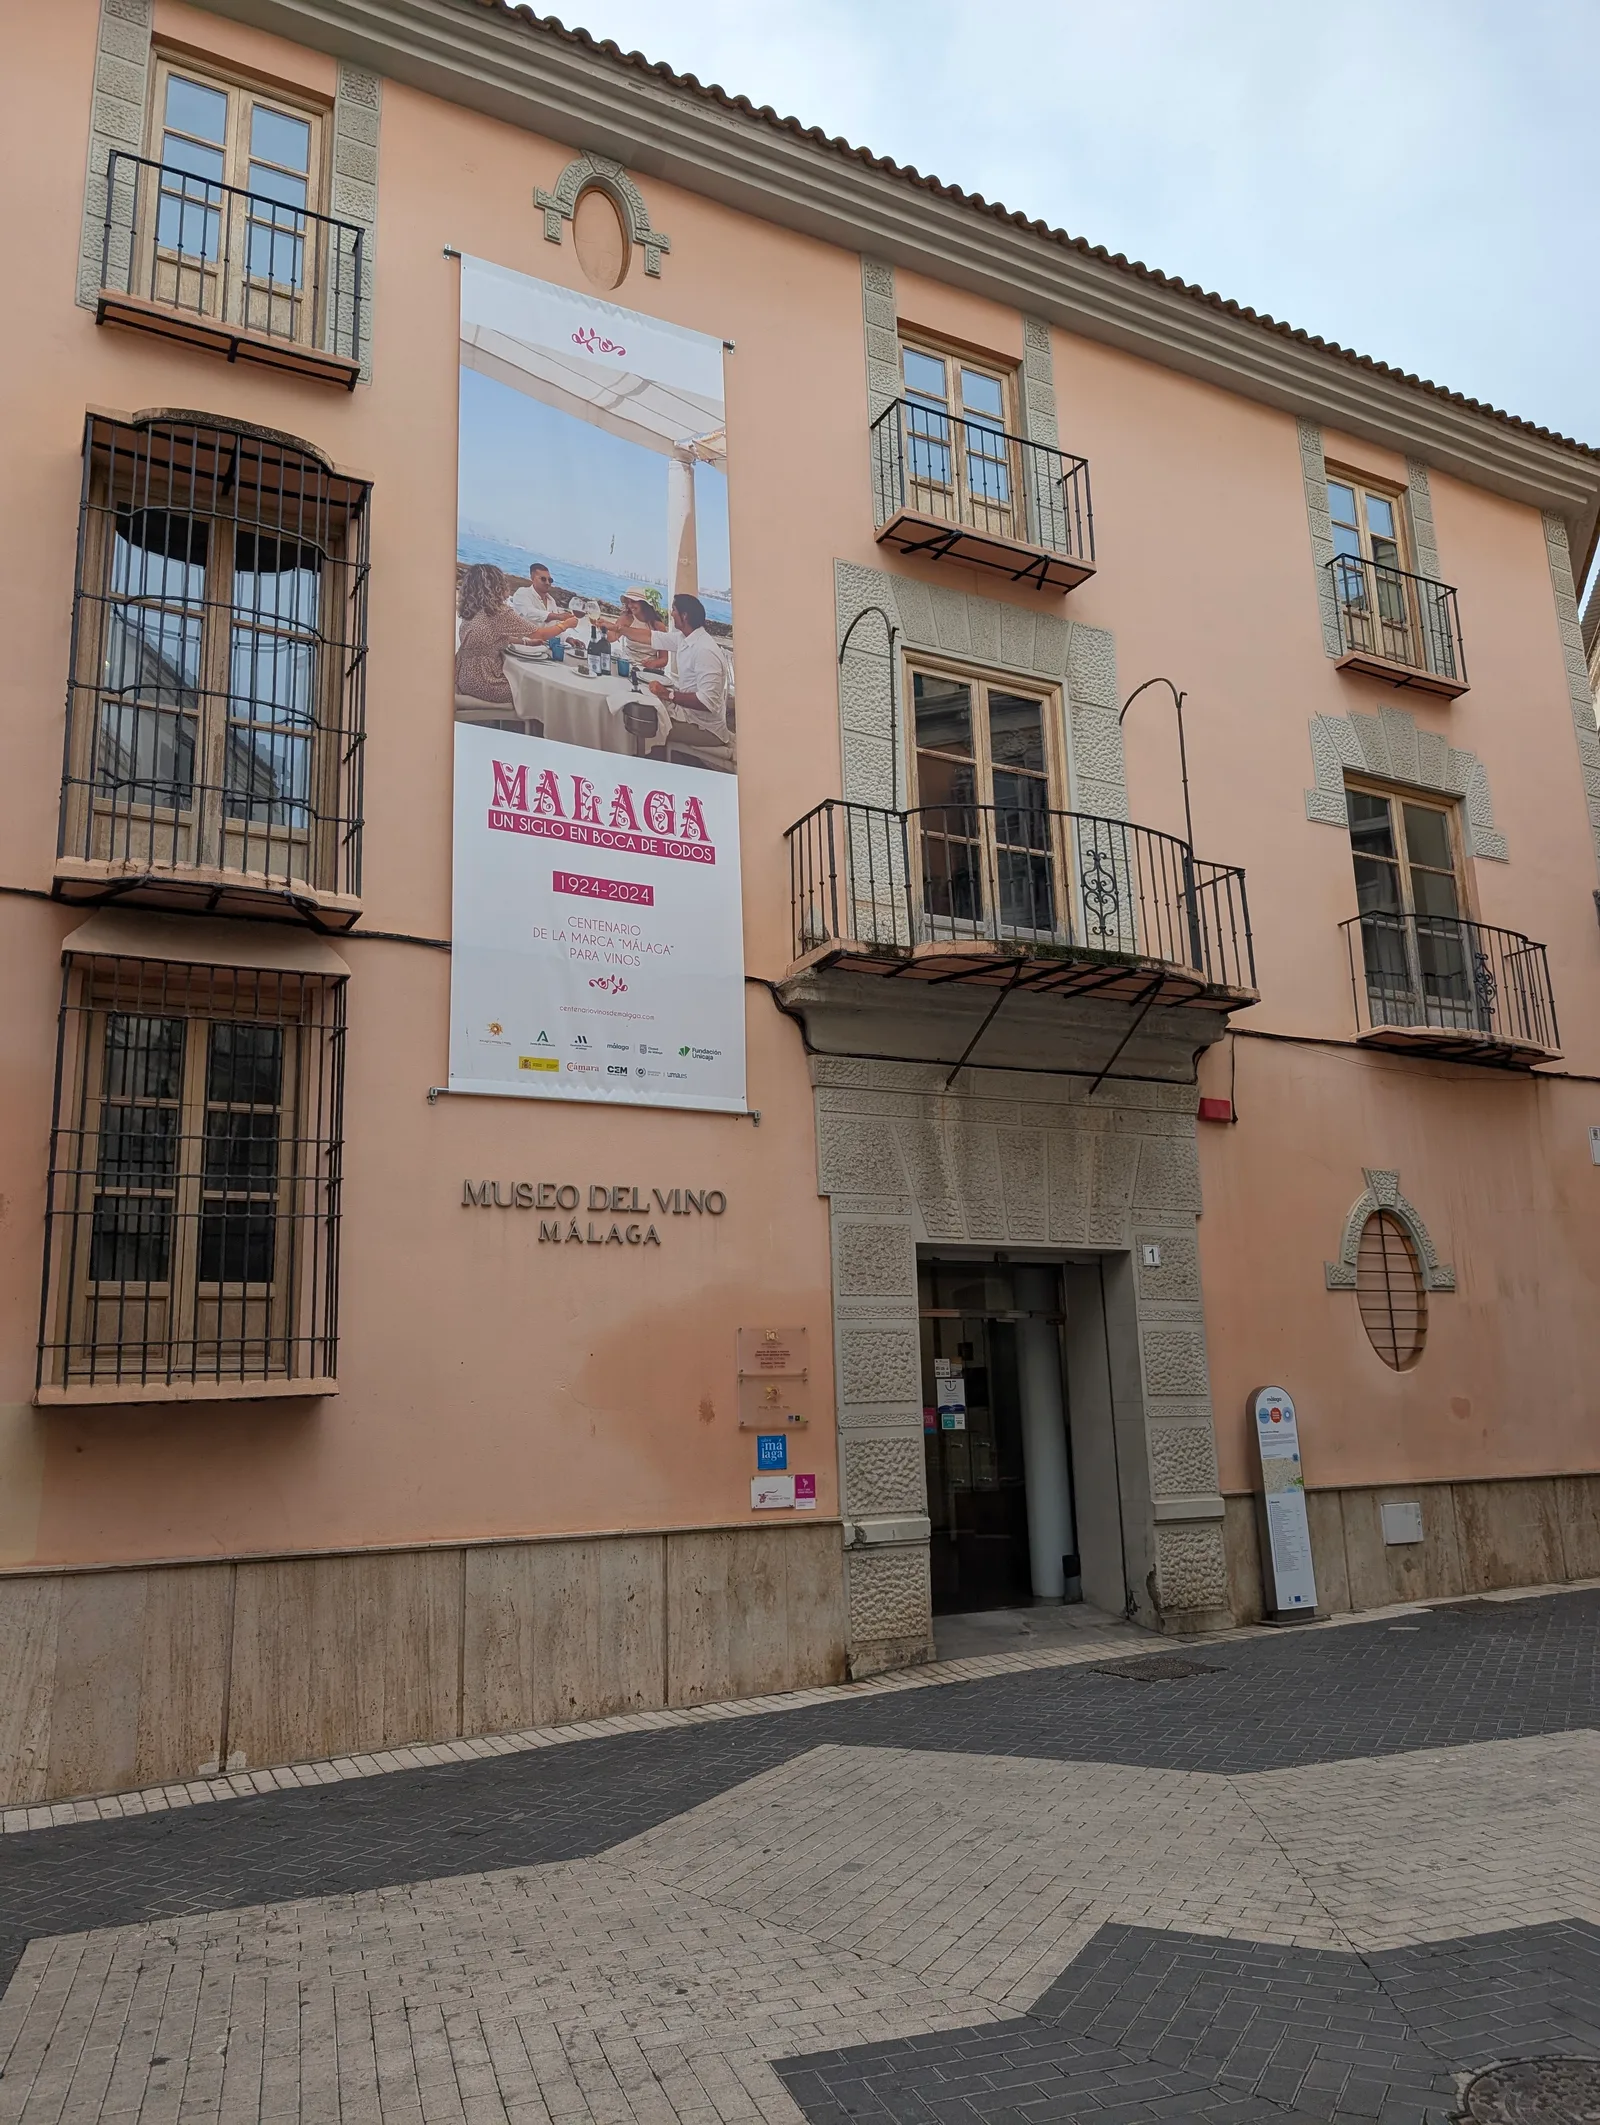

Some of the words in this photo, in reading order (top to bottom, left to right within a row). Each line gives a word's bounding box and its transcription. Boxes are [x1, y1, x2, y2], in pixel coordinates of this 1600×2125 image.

[491, 759, 712, 843] MALAGA
[493, 812, 514, 829] UN
[519, 817, 564, 837] SIGLO
[570, 826, 588, 841] EN
[593, 831, 636, 850] BOCA
[641, 839, 658, 853] DE
[662, 841, 712, 861] TODOS
[561, 875, 650, 903] 1924-2024
[533, 926, 548, 940] DE
[552, 930, 567, 942] LA
[571, 932, 615, 948] MARCA
[567, 916, 641, 937] CENTENARIO
[569, 947, 600, 962] PARA
[604, 952, 641, 967] VINOS
[692, 1047, 722, 1056] Fundación
[607, 1065, 628, 1074] CEM
[461, 1179, 580, 1209] MUSEO
[587, 1184, 650, 1212] DEL
[652, 1188, 727, 1215] VINO
[538, 1216, 661, 1246] MÁLAGA
[1148, 1248, 1155, 1262] 1
